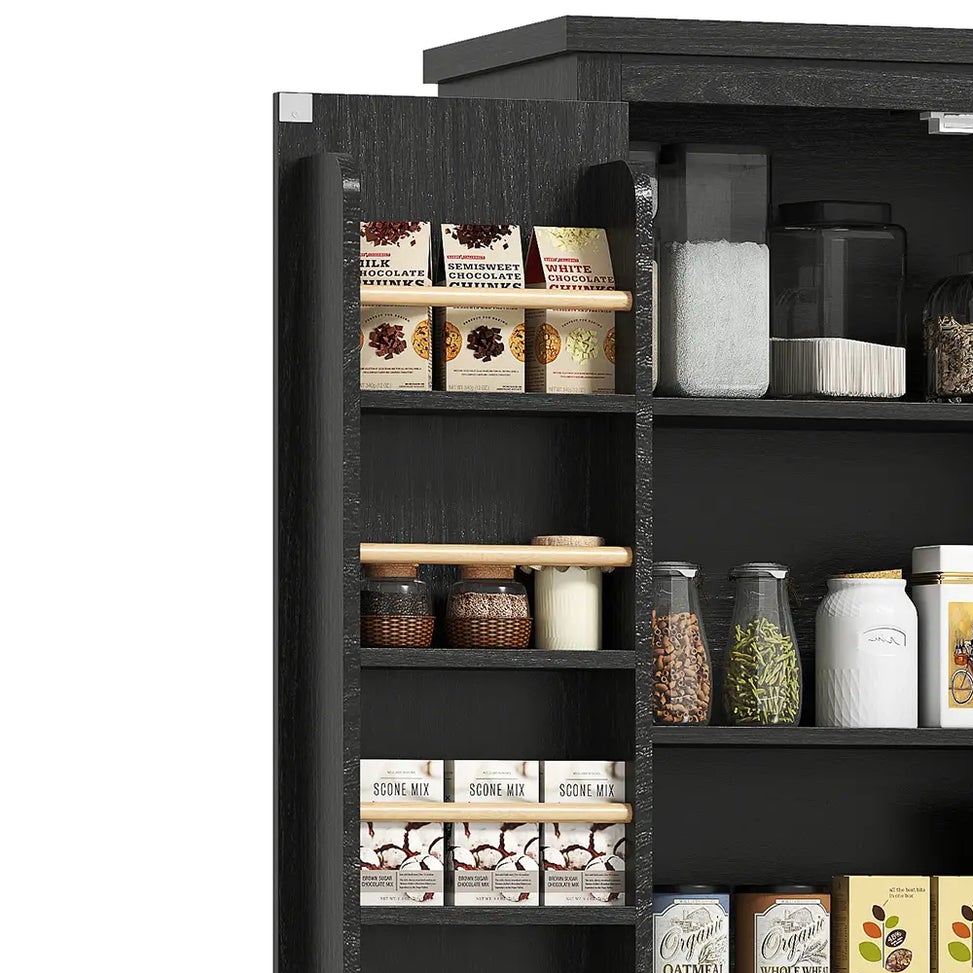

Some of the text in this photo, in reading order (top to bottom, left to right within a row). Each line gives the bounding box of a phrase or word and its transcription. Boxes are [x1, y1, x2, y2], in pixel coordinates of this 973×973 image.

[448, 263, 520, 271] SEMISWEET
[546, 264, 592, 274] WHITE
[449, 272, 522, 280] CHOCOLATE
[548, 275, 615, 283] CHOCOLATE
[373, 783, 430, 796] SCONE MIX
[469, 783, 525, 797] SCONE MIX
[559, 783, 615, 797] SCONE MIX
[660, 915, 724, 962] Organic
[762, 916, 825, 962] Organic
